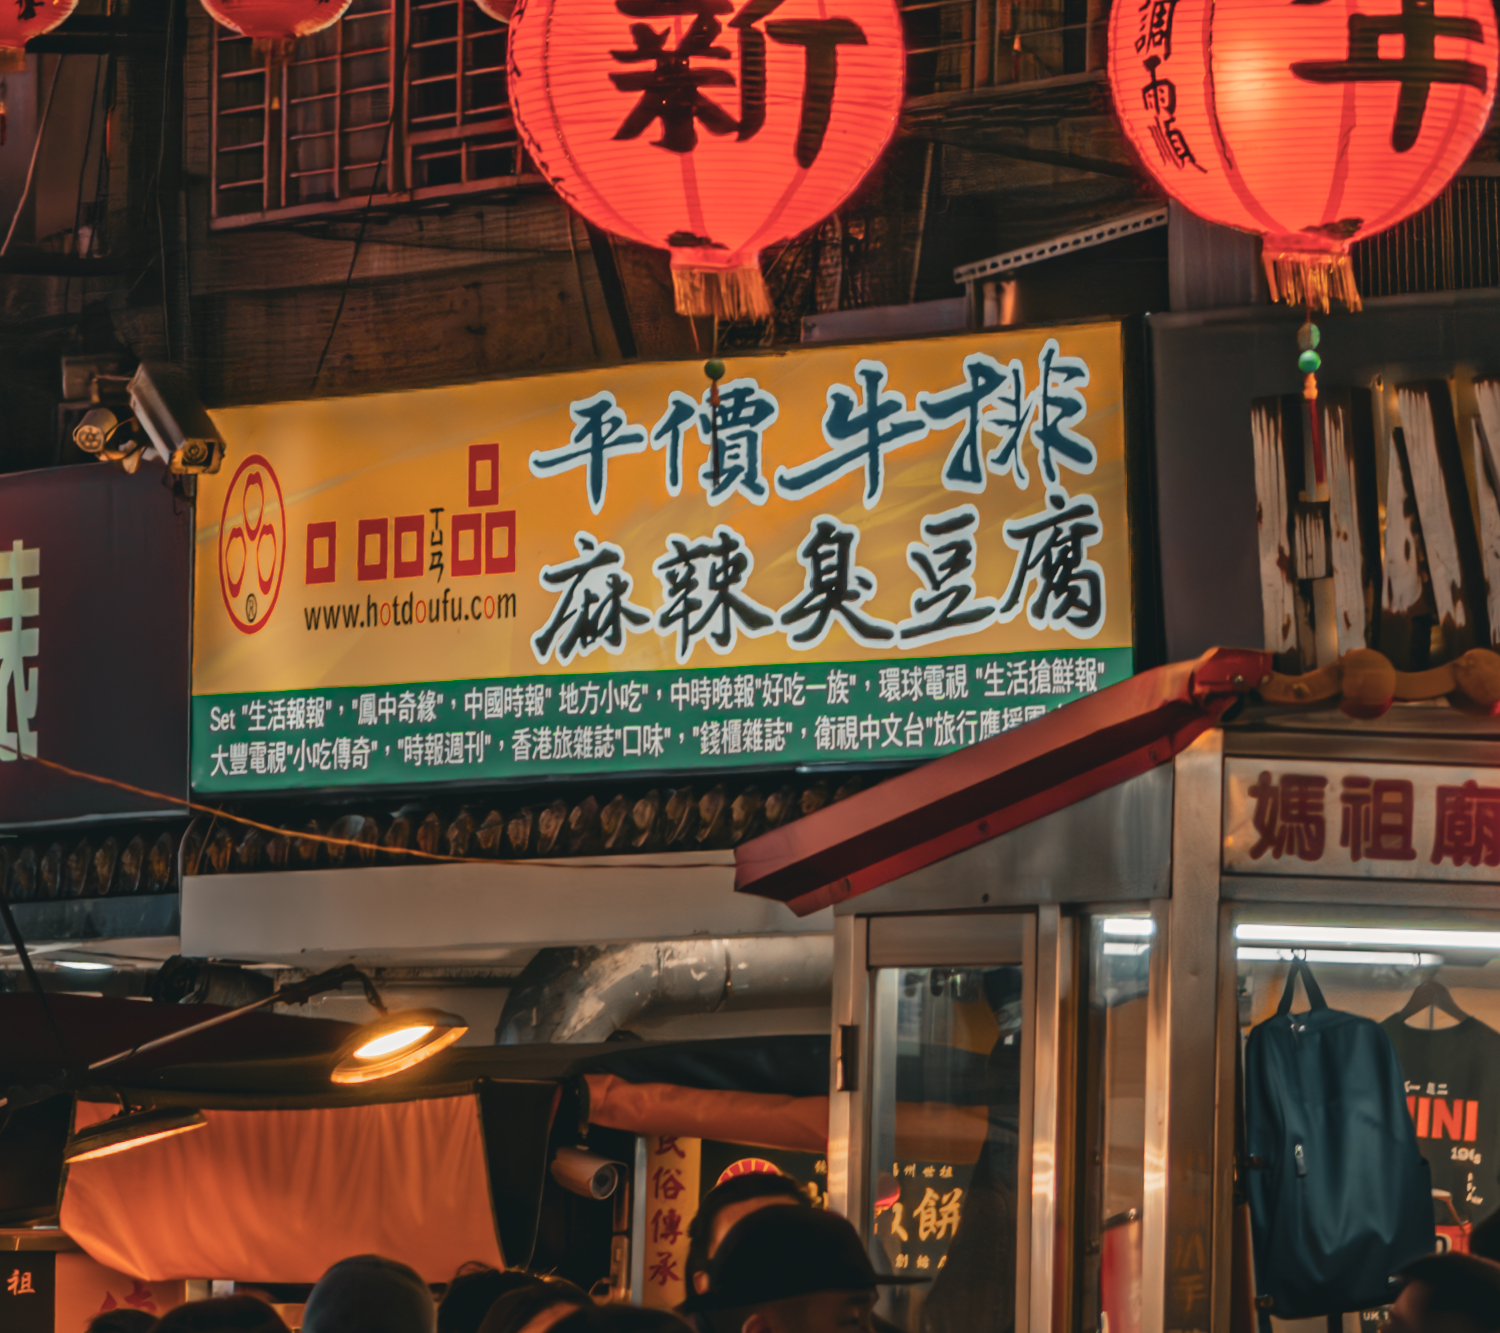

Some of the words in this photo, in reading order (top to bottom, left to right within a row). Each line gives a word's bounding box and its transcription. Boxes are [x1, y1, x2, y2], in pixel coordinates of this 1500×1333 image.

[532, 337, 1099, 515] 平價牛排
[304, 587, 518, 633] www.hotdoufu.com
[530, 493, 1106, 667] 麻辣臭豆腐
[210, 704, 236, 732] Set
